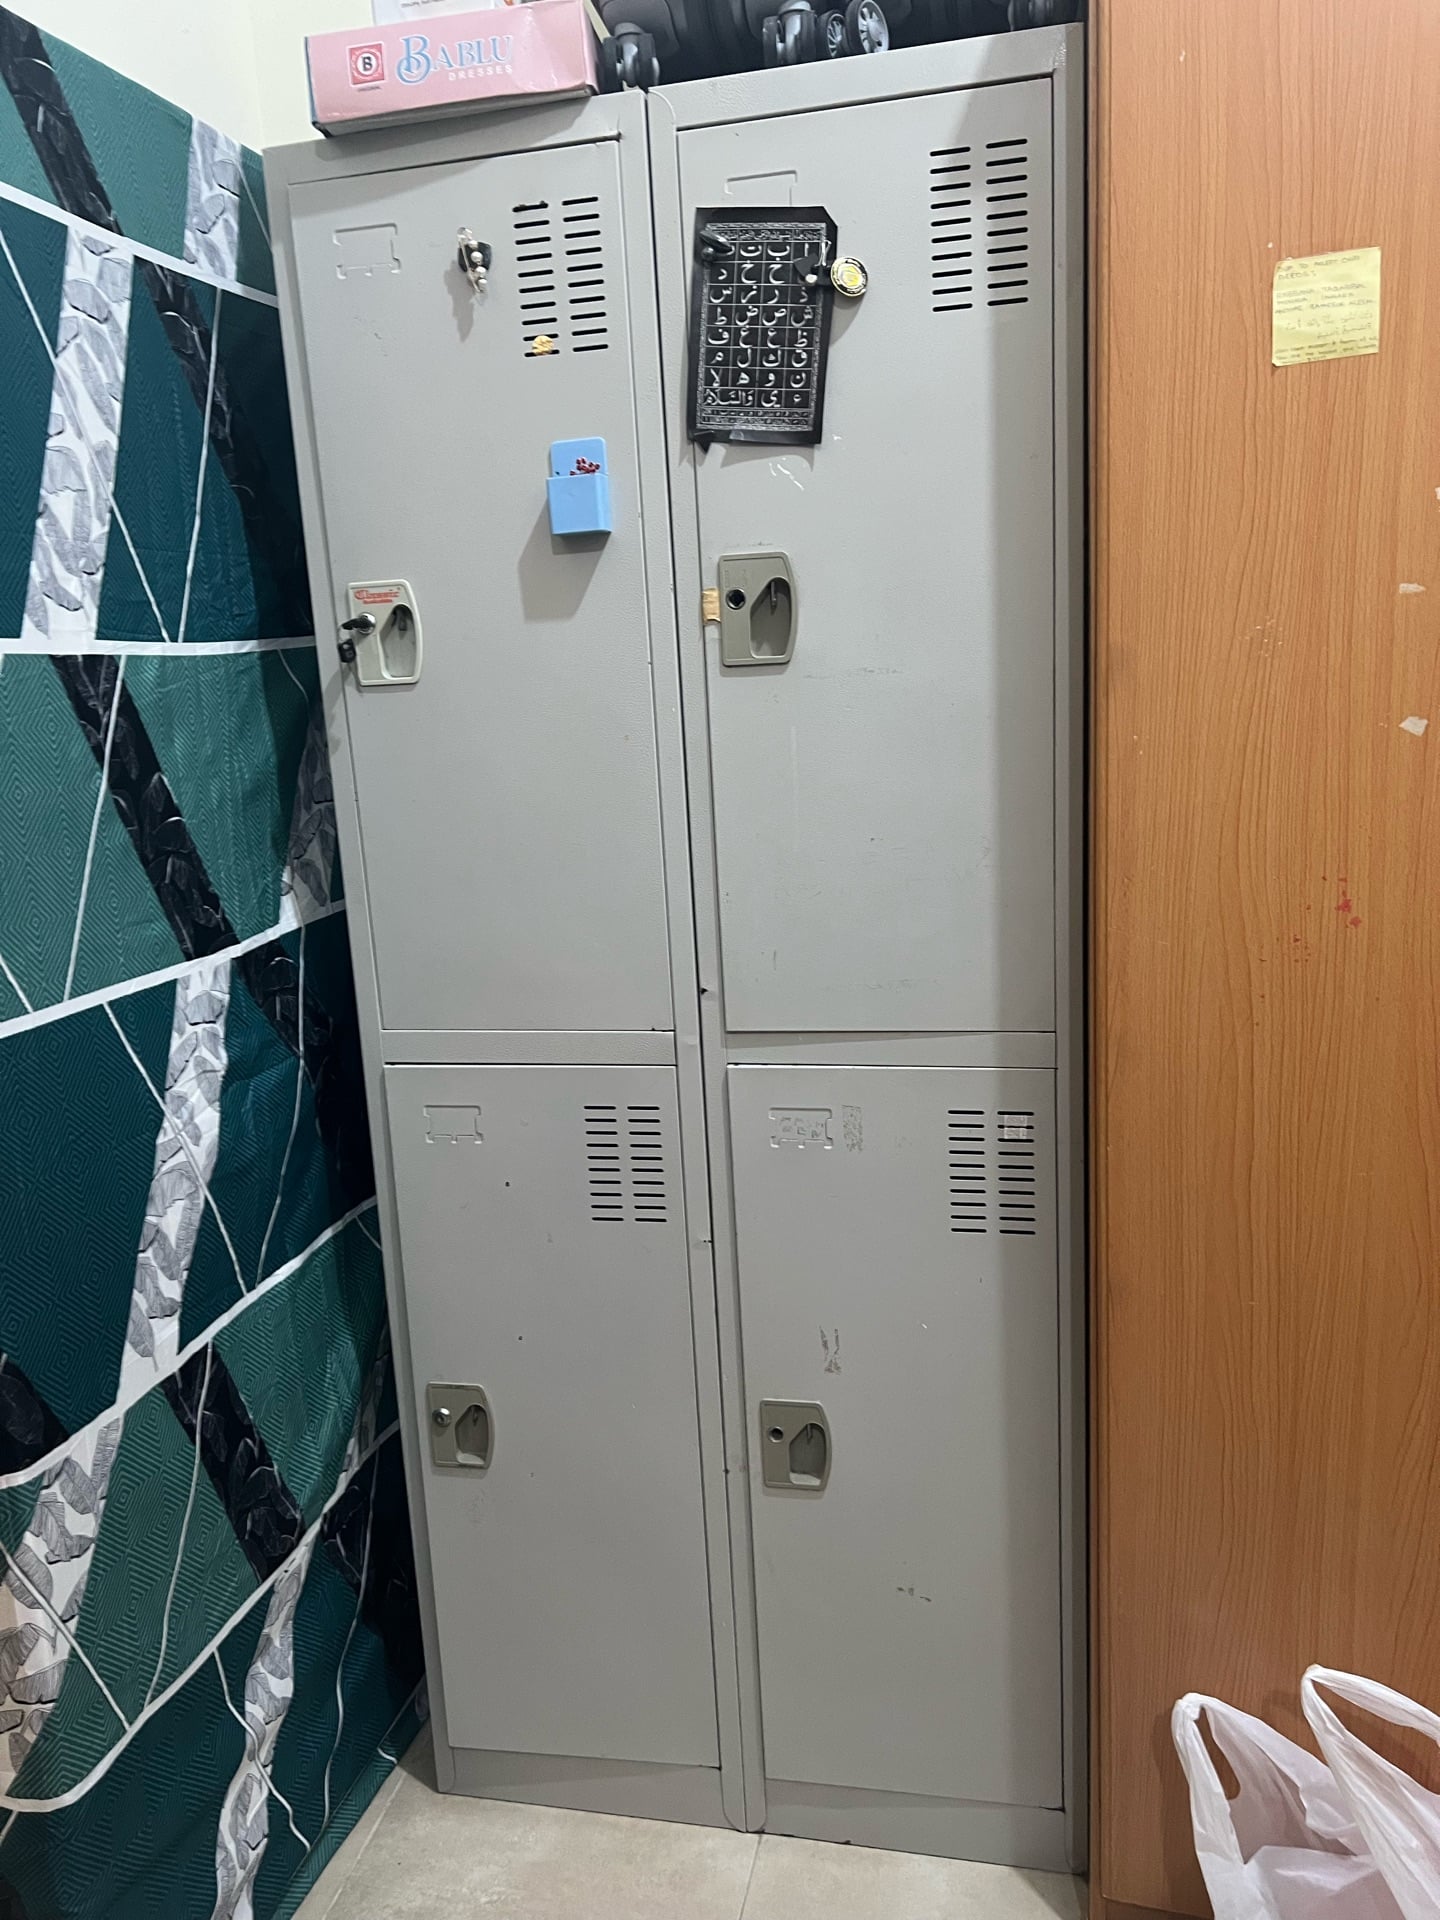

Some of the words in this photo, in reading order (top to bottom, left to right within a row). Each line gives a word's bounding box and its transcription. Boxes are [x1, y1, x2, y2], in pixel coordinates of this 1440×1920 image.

[449, 64, 513, 81] DRESSES
[740, 244, 762, 257] ت
[767, 245, 790, 261] ب
[718, 268, 728, 280] د
[741, 260, 757, 284] خ
[769, 263, 785, 284] ح
[741, 285, 757, 304] ز
[767, 289, 779, 304] ر
[714, 307, 727, 325] ط
[735, 306, 758, 326] ض
[762, 308, 787, 326] ص
[791, 306, 813, 326] ش
[707, 328, 729, 345] ف
[739, 325, 753, 348] غ
[767, 328, 781, 348] ع
[794, 330, 808, 347] ظ
[710, 351, 724, 364] م
[736, 349, 751, 368] ل
[762, 349, 781, 367] ك
[791, 349, 808, 367] ق
[736, 372, 749, 385] ه
[764, 373, 775, 386] و
[790, 372, 806, 388] ن
